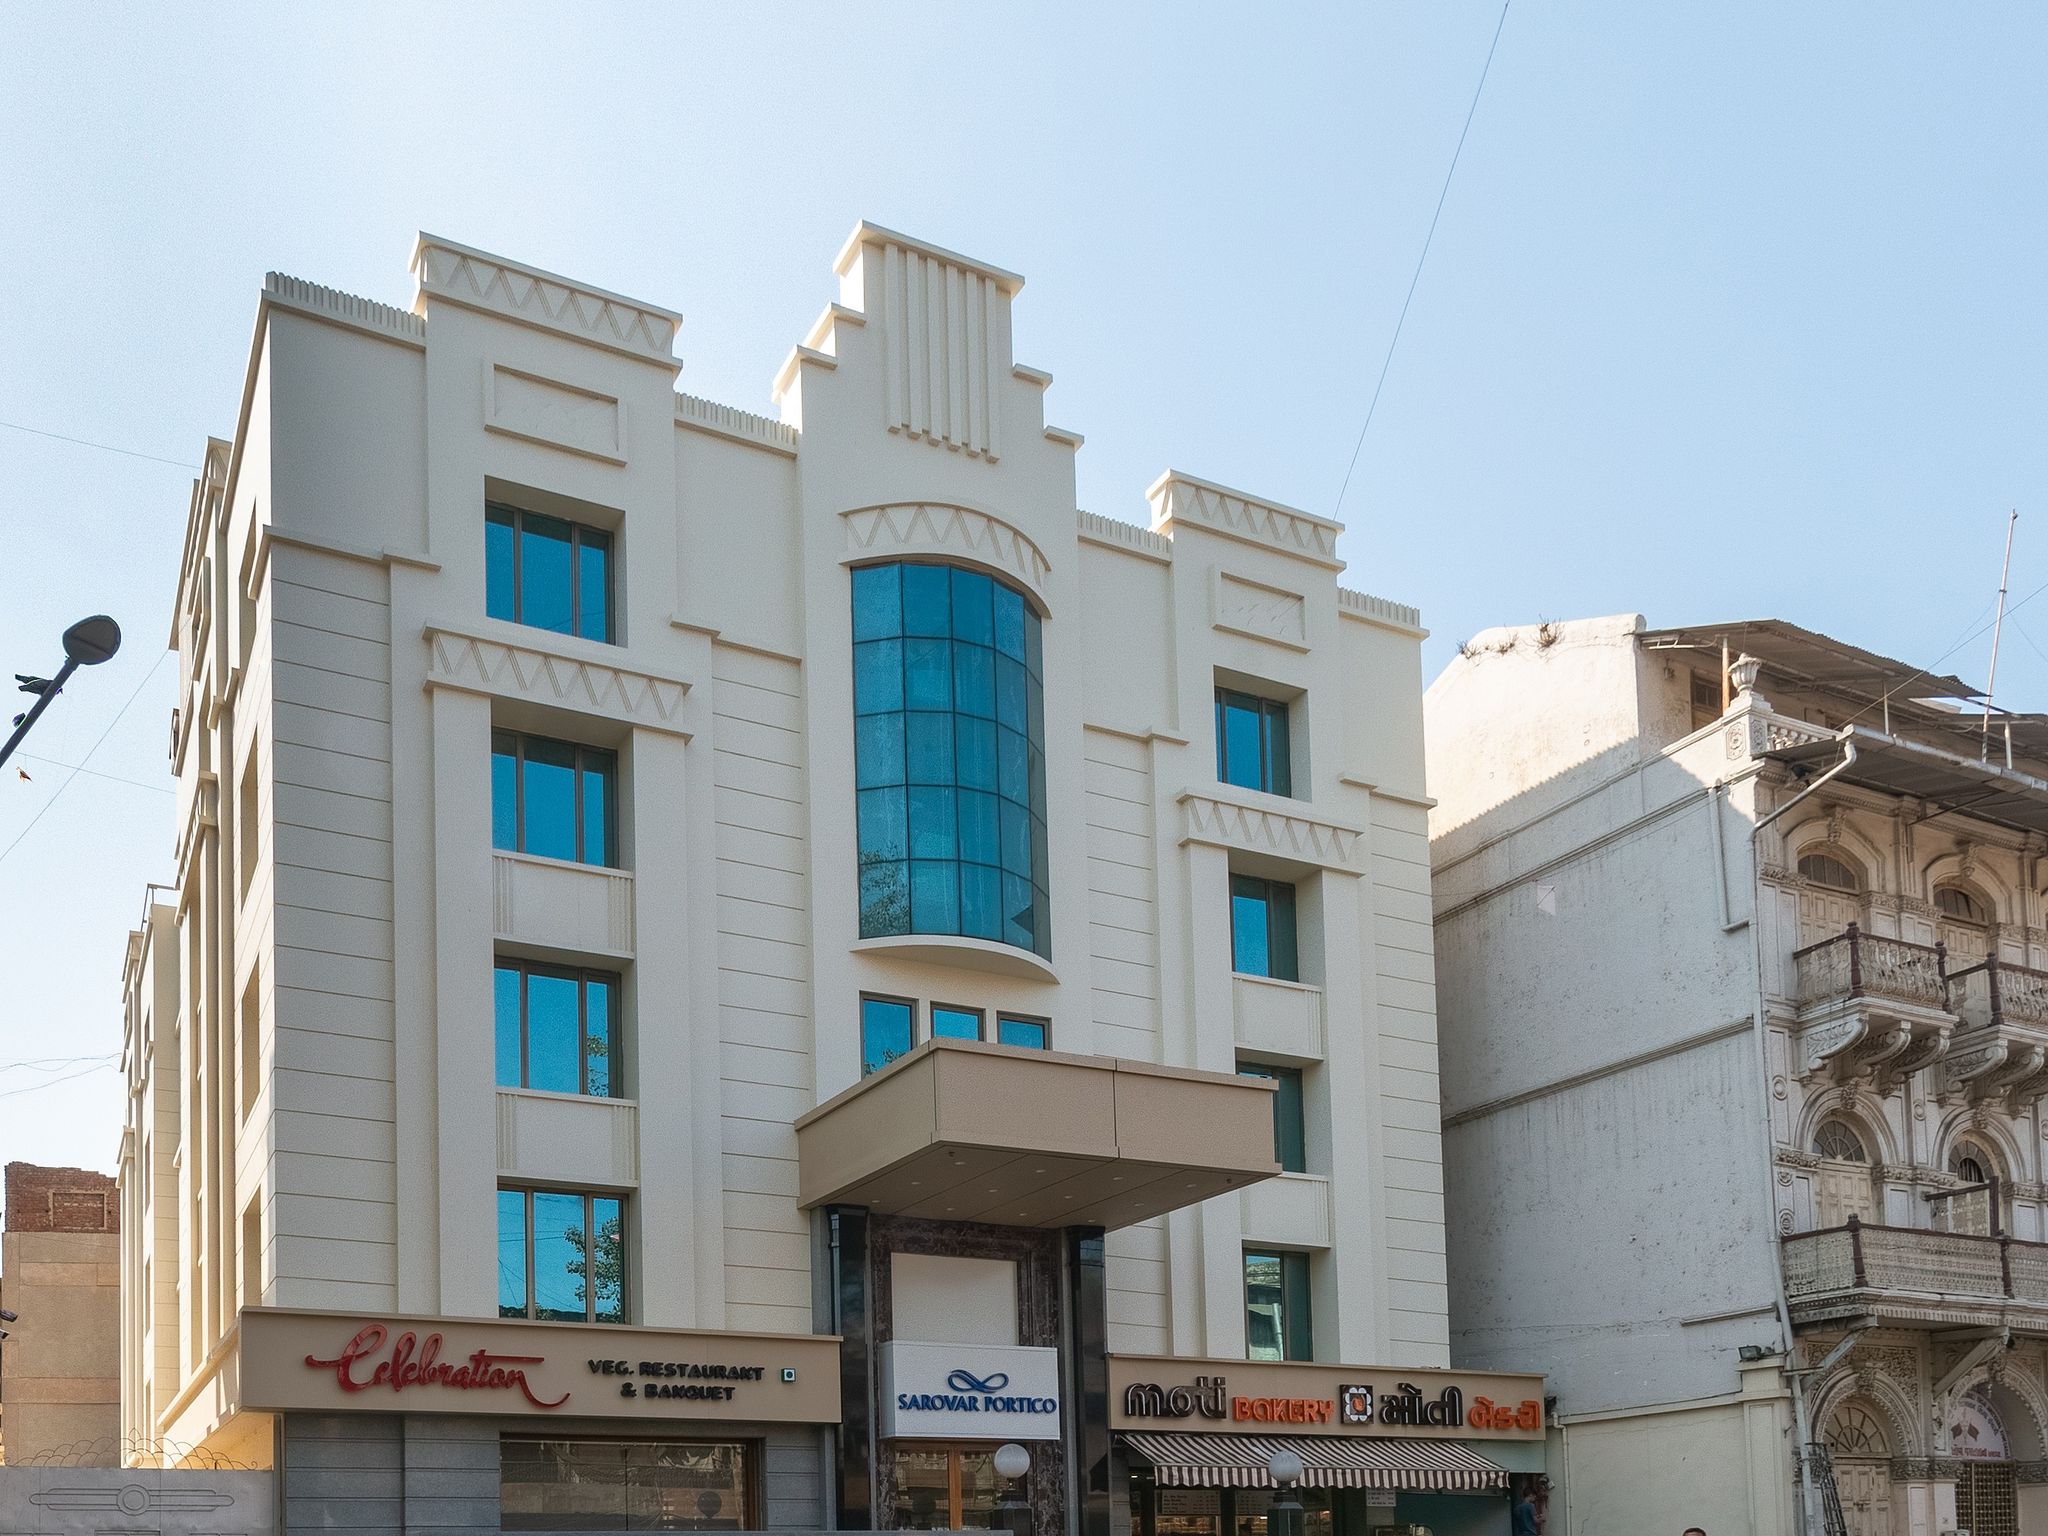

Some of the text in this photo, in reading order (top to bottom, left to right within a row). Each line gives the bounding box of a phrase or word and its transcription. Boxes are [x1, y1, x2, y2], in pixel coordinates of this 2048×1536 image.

[304, 1323, 571, 1409] Celebration
[587, 1359, 765, 1381] VEG. RESTAURANT
[620, 1382, 735, 1401] & BANQUET
[898, 1393, 1057, 1414] SAROVAR PORTICO
[1378, 1382, 1541, 1430] મોતી બેકરી
